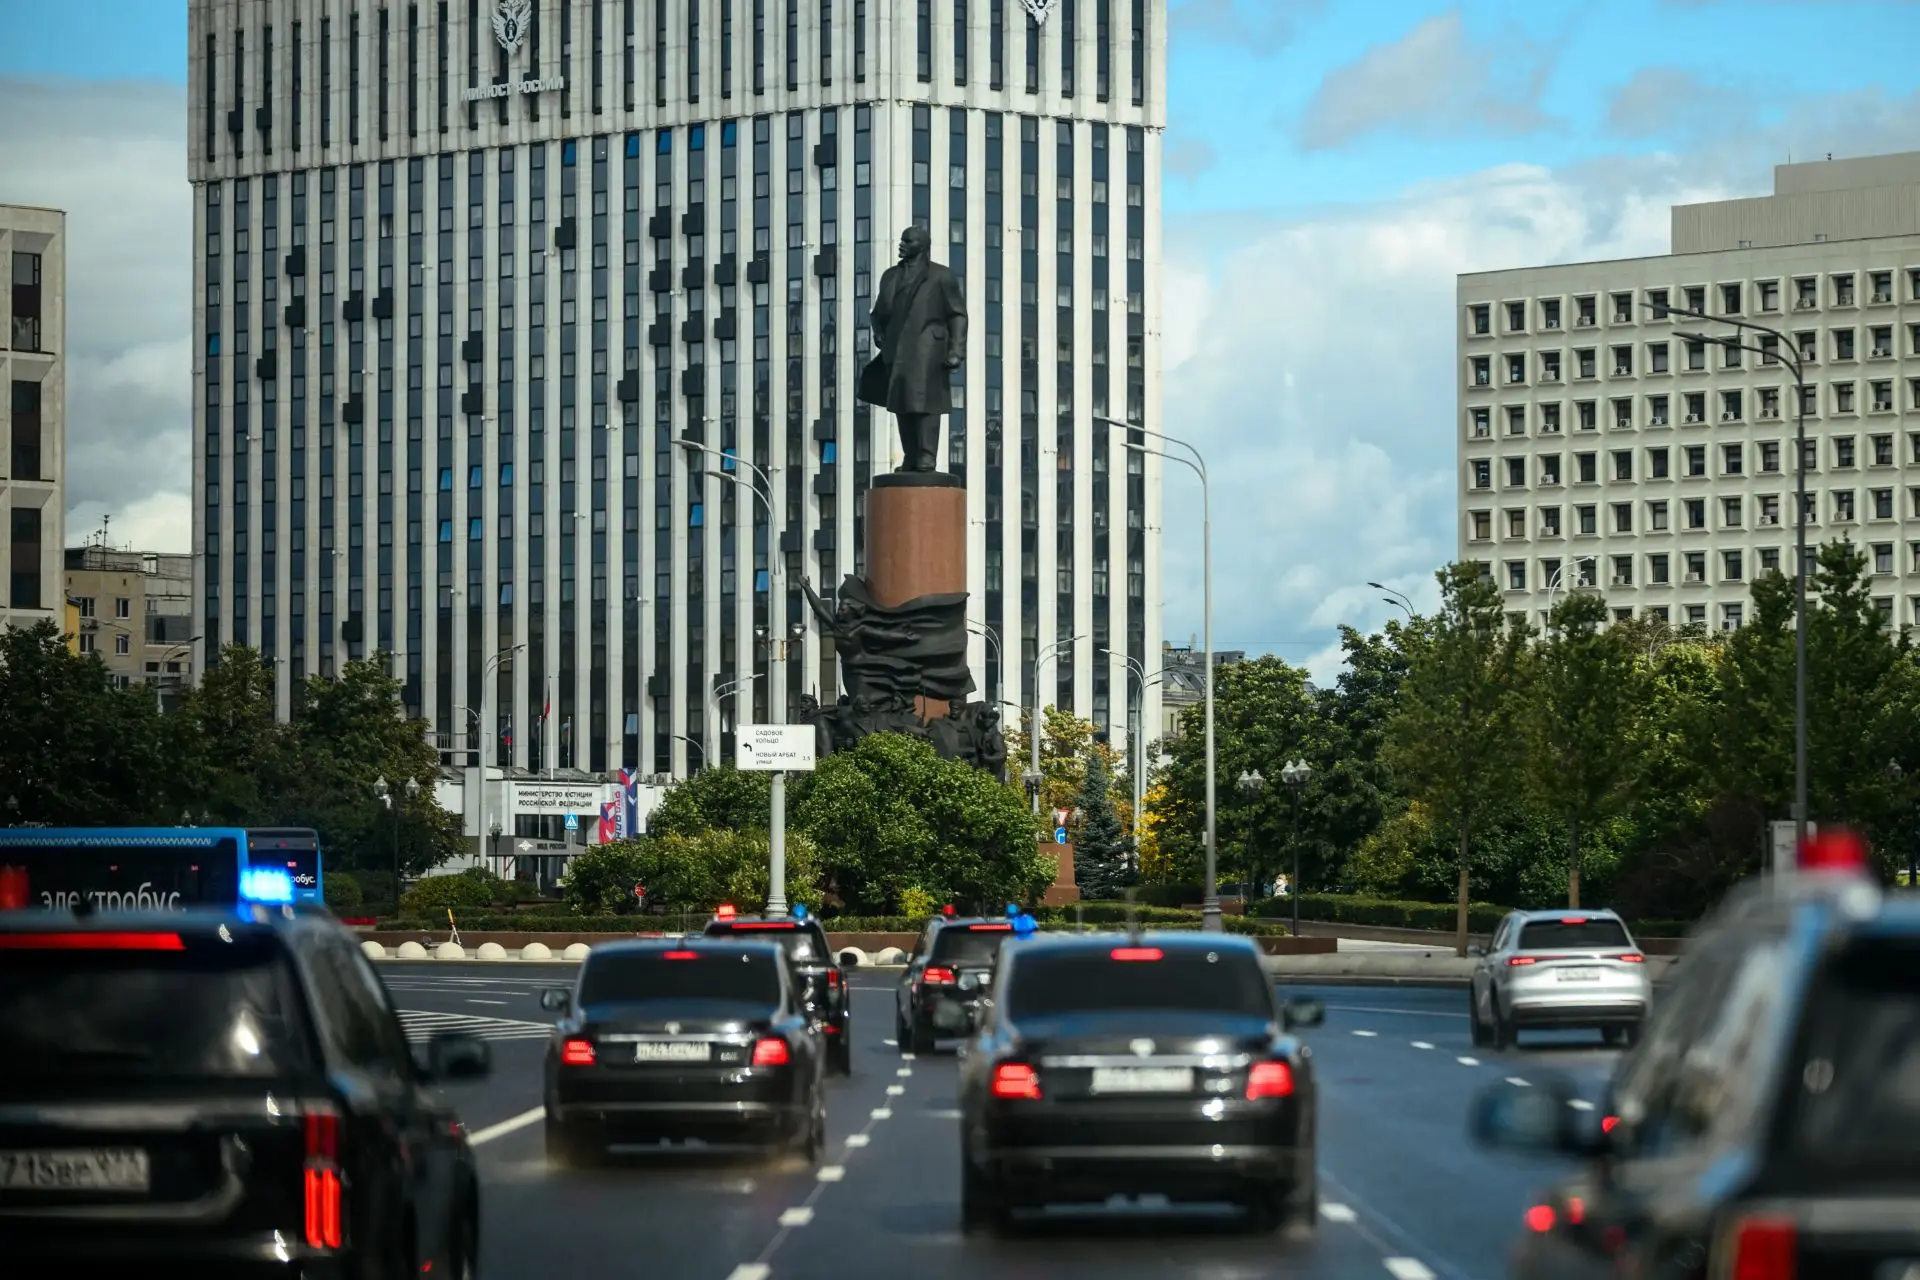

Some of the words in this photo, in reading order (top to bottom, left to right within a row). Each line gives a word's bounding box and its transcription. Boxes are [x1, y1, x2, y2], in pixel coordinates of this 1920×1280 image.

[461, 82, 512, 101] МИНЮСТ
[517, 76, 564, 94] РОССИИ
[41, 881, 187, 912] элетробус.
